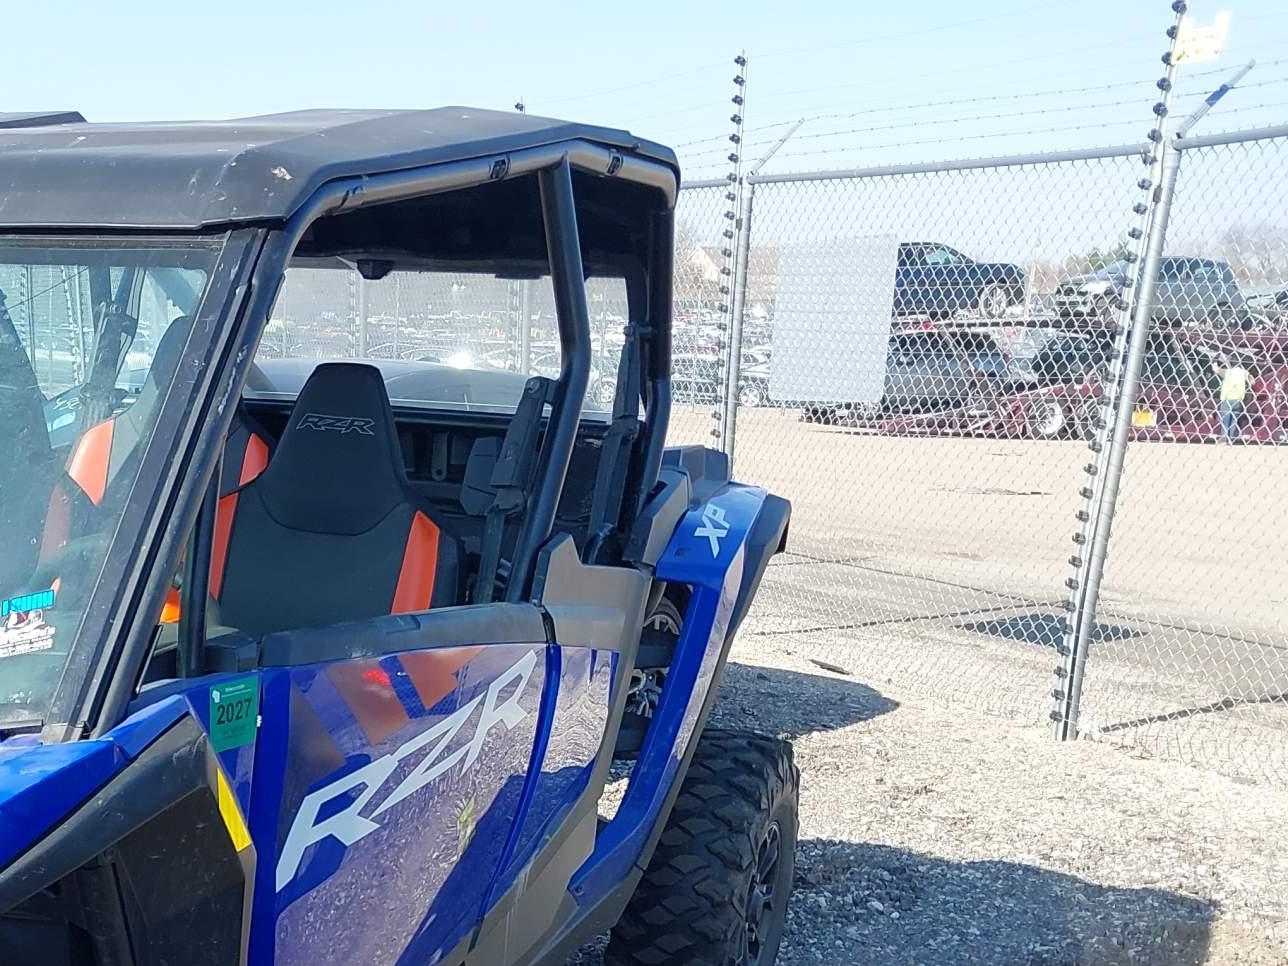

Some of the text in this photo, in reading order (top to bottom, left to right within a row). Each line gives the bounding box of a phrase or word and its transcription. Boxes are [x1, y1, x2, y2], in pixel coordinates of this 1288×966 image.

[295, 413, 375, 436] RZR
[694, 503, 730, 559] XP
[216, 698, 252, 726] 2027
[275, 649, 537, 893] RZR
